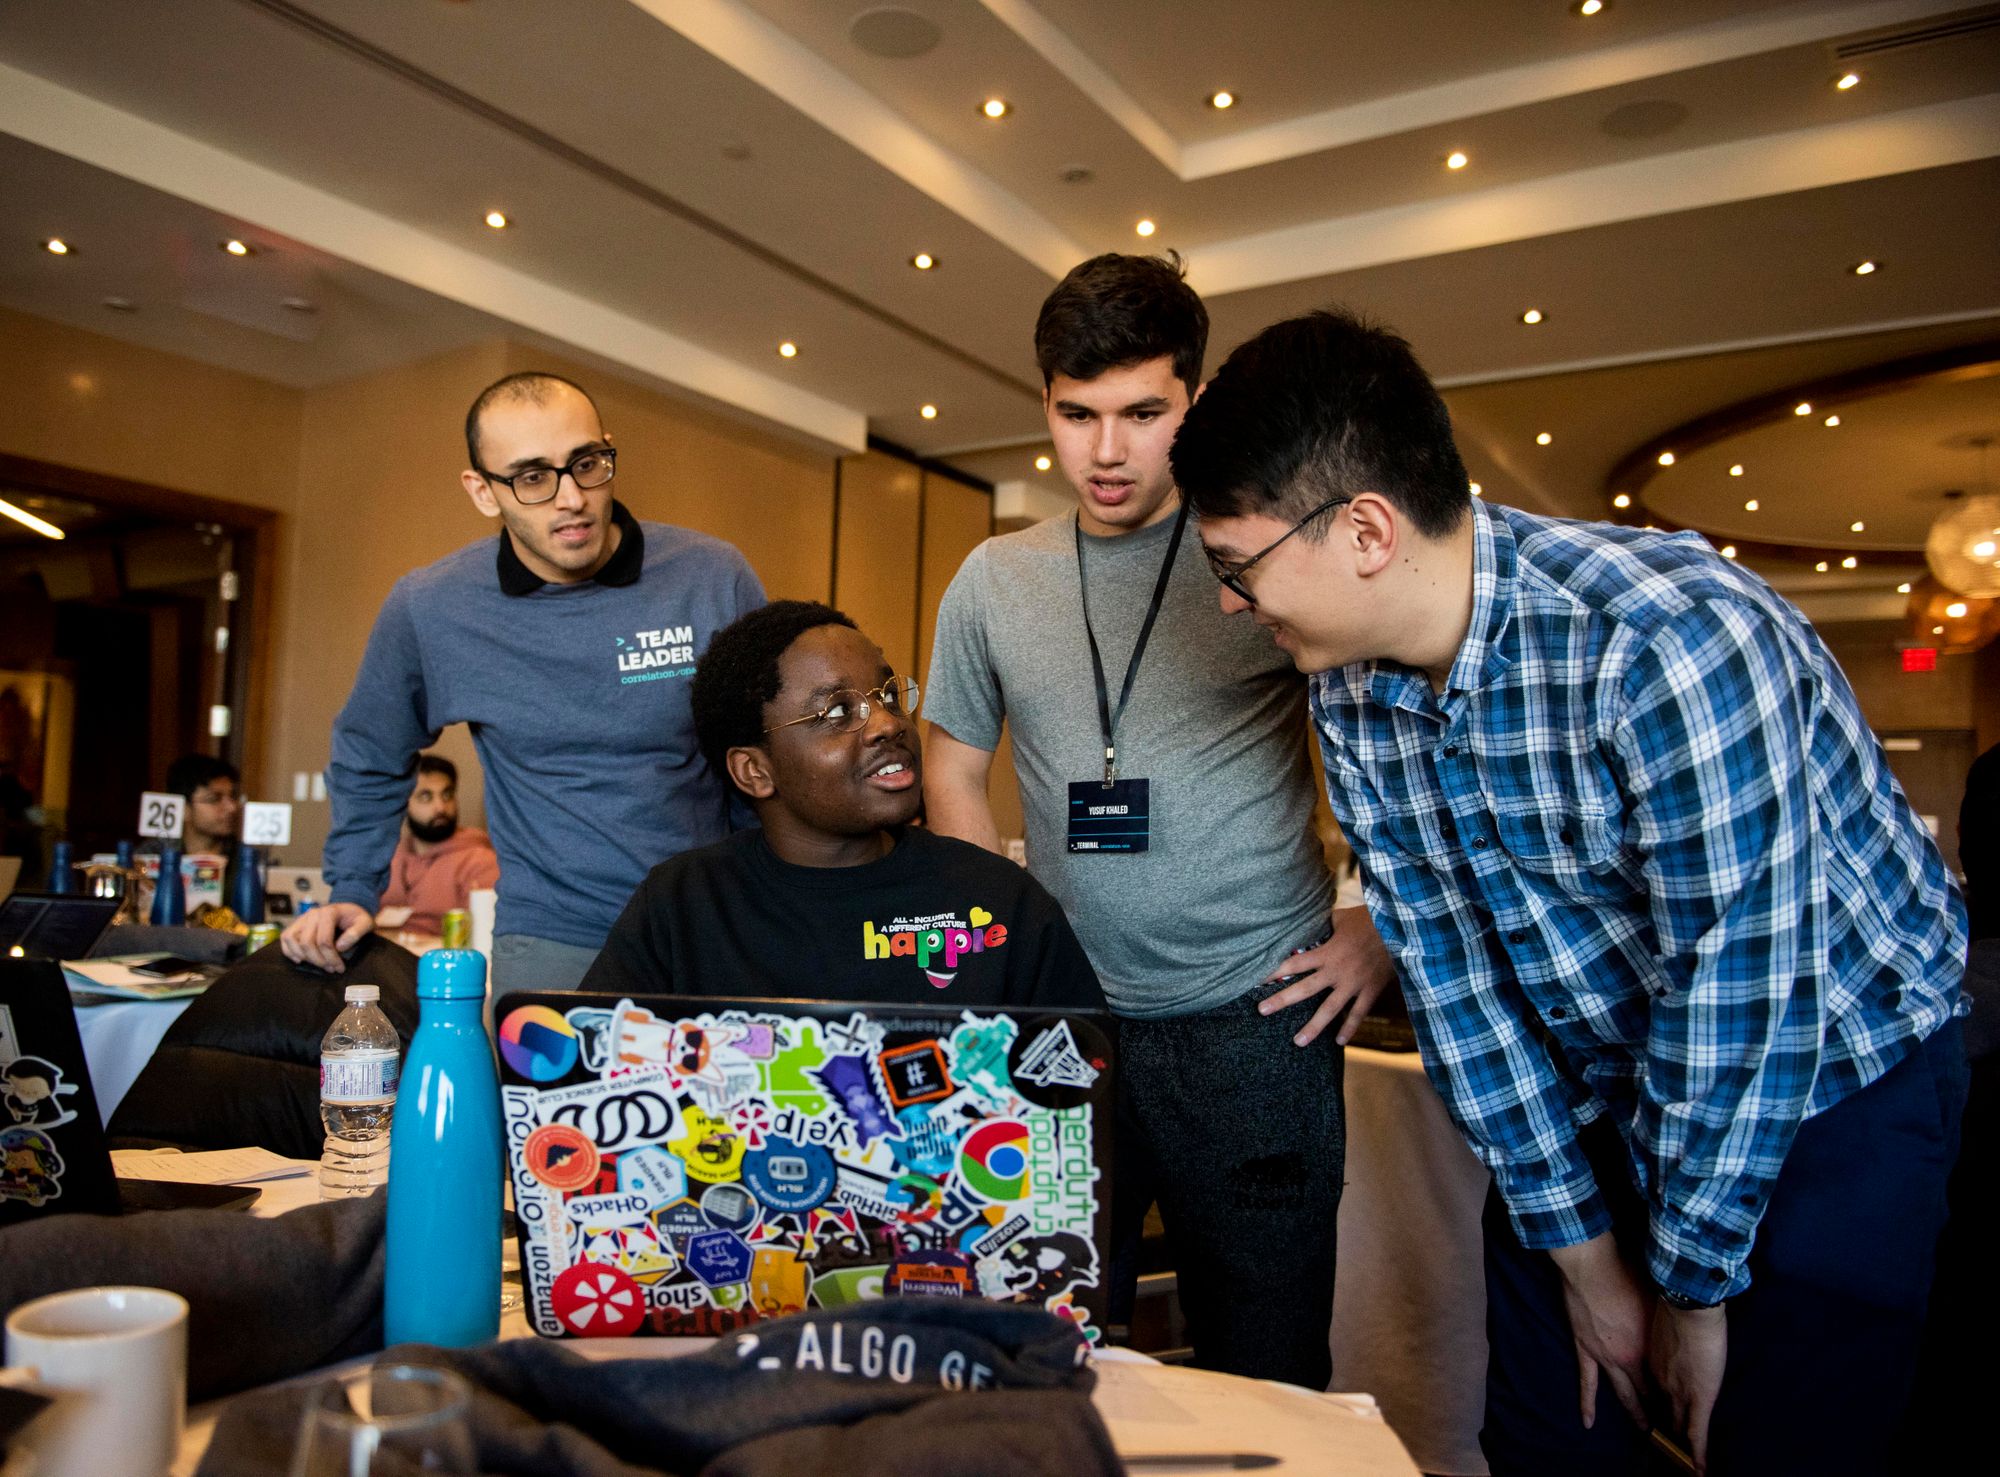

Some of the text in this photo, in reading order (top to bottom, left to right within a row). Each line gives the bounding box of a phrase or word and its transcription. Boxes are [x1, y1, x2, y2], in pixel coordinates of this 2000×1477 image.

[636, 626, 694, 649] TEAM
[618, 646, 694, 671] LEADER
[147, 802, 176, 830] 26
[1088, 805, 1128, 815] YUSUF KHALED
[253, 811, 282, 837] 25
[881, 920, 967, 933] A DIFFERENT CULTURE
[892, 916, 908, 924] ALL
[914, 912, 956, 924] INCLUSIVE
[863, 907, 1008, 968] happie
[564, 1084, 607, 1100] SCIENCE
[774, 1109, 849, 1146] yelp
[571, 1195, 649, 1217] QHacks
[840, 1189, 900, 1223] GitHub
[531, 1245, 559, 1333] amazon
[904, 1283, 959, 1297] Western
[796, 1322, 917, 1384] ALGO
